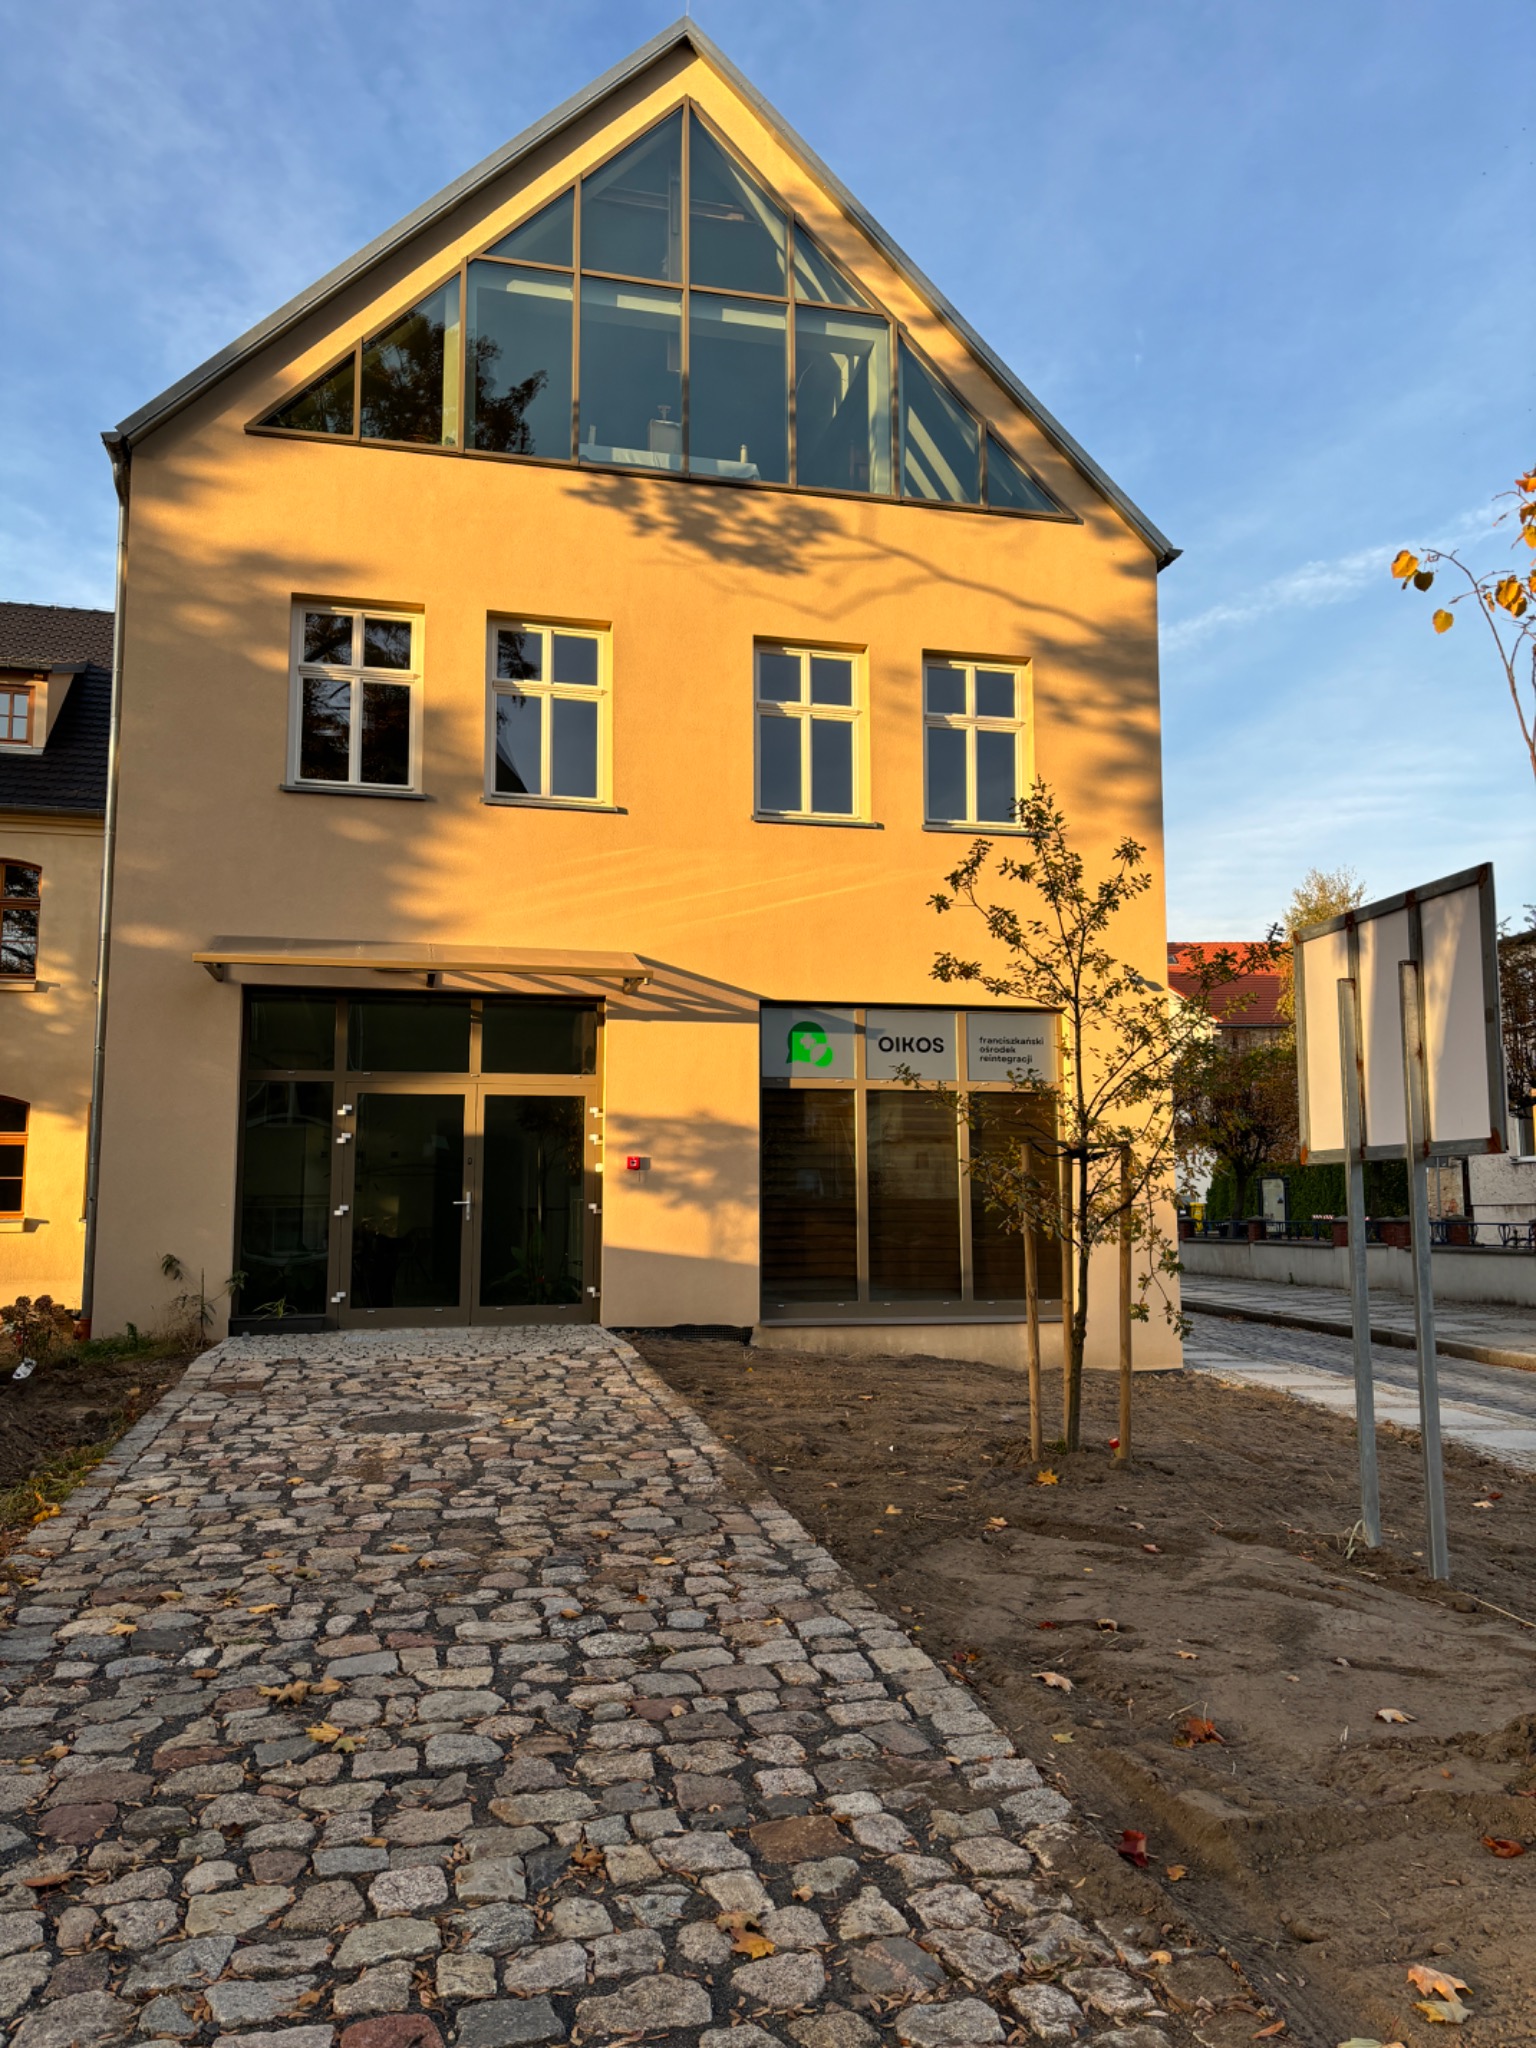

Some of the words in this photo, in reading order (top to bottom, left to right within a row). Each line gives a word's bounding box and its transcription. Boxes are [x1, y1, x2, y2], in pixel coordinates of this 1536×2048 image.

[878, 1036, 944, 1053] OIKOS
[979, 1036, 1044, 1045] franciszkański
[979, 1045, 1016, 1053] ośrodek
[979, 1054, 1033, 1065] reintegracji
